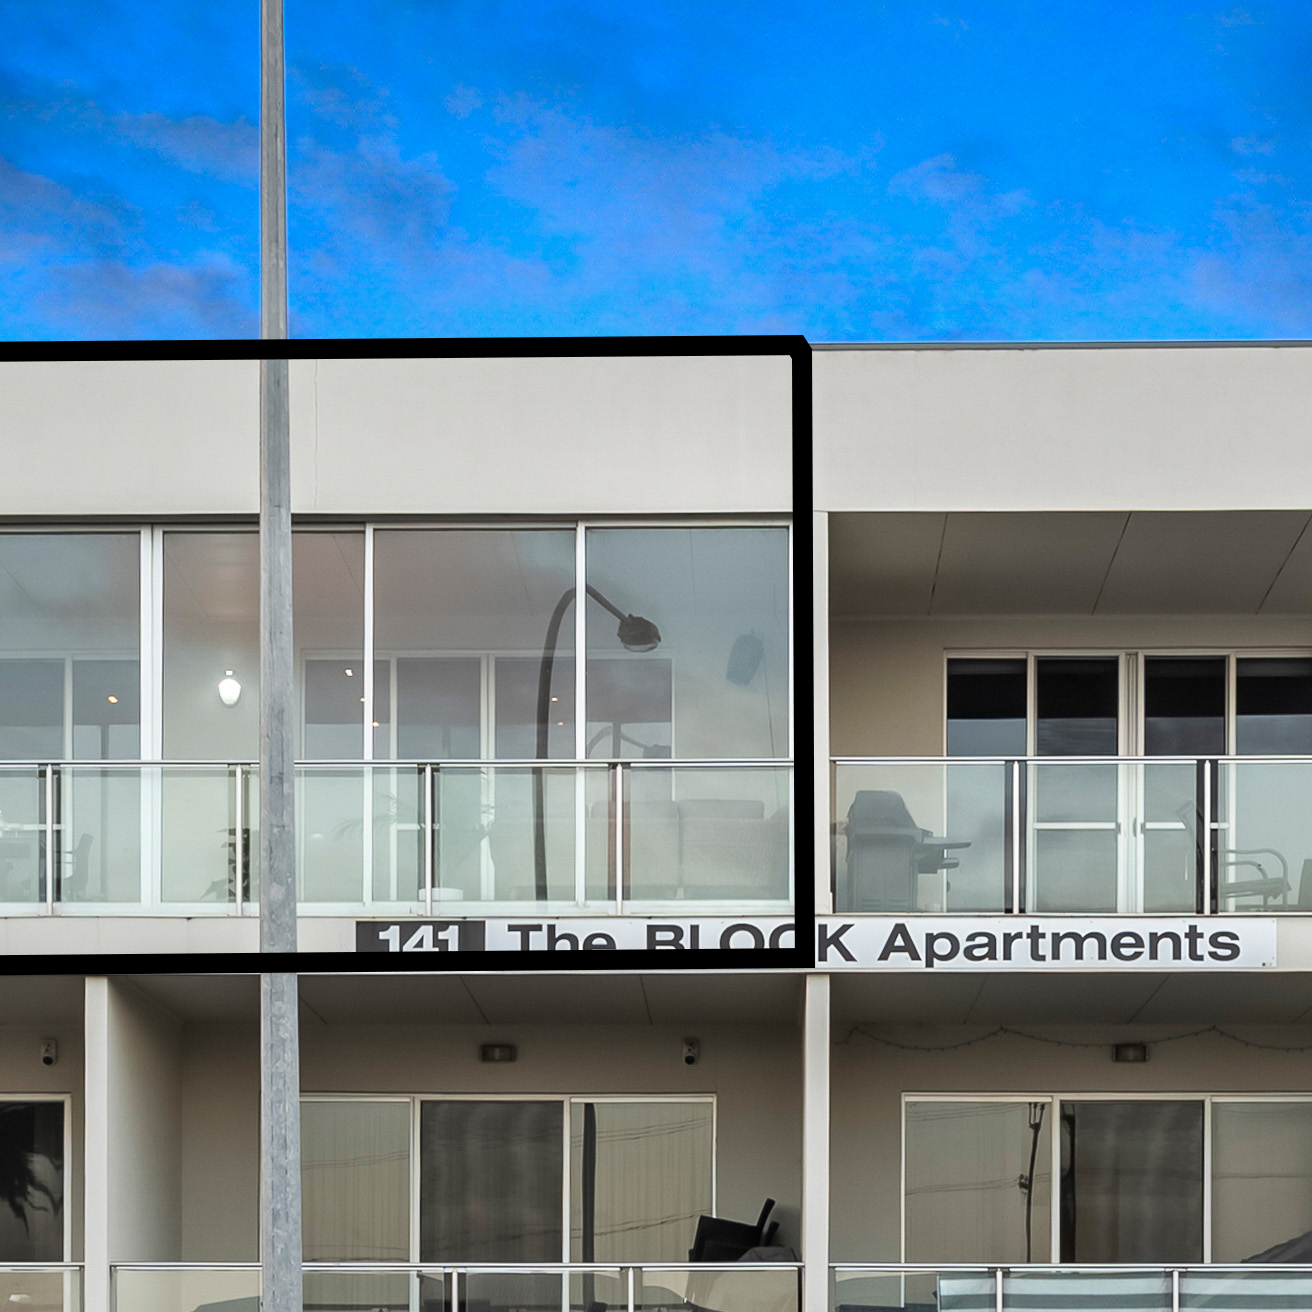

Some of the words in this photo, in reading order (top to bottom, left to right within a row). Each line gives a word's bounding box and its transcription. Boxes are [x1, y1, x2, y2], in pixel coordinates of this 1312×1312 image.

[378, 924, 460, 951] 141
[507, 924, 617, 950] The
[877, 922, 1241, 968] Apartments
